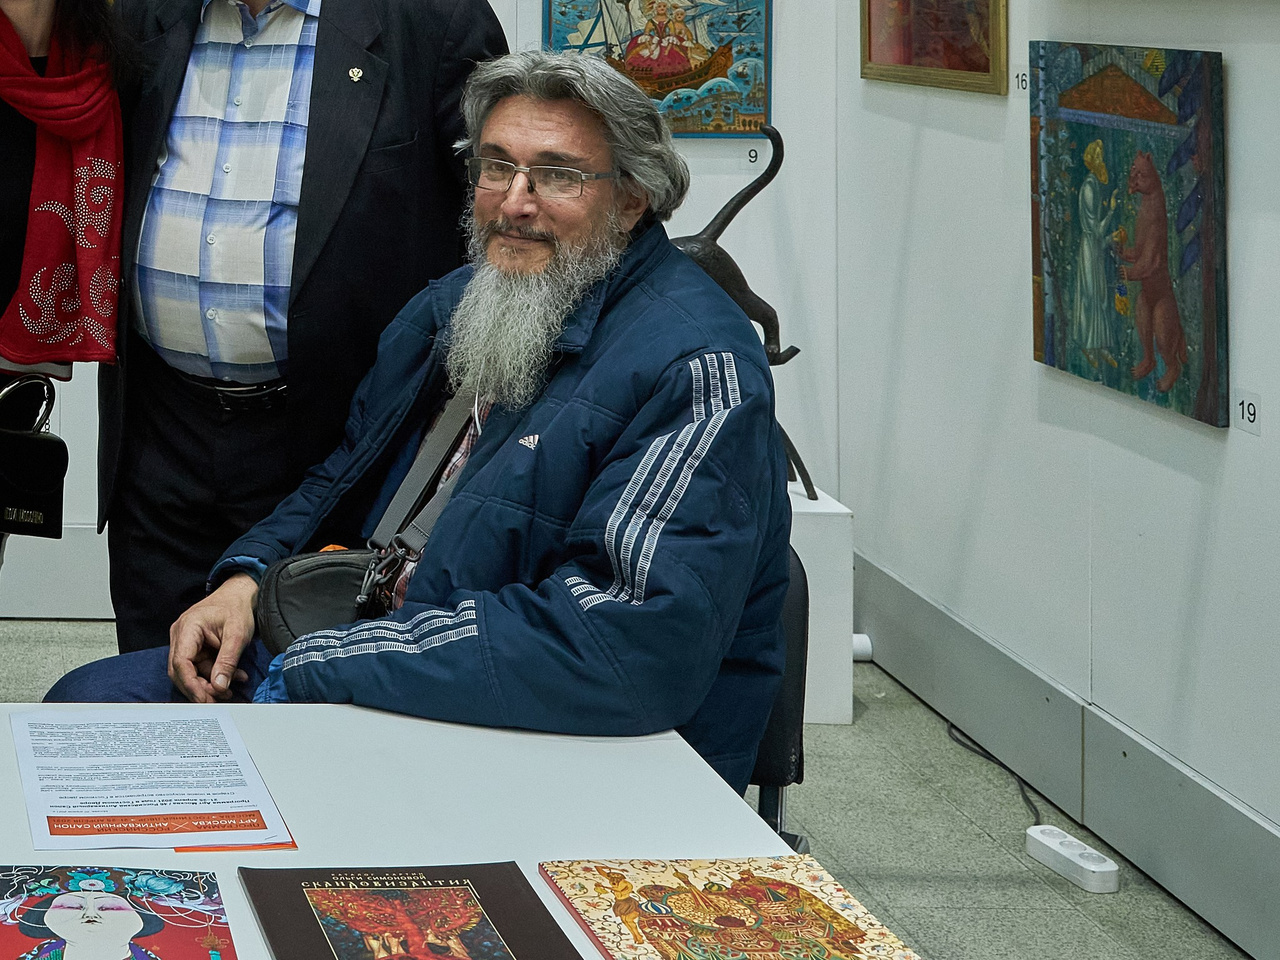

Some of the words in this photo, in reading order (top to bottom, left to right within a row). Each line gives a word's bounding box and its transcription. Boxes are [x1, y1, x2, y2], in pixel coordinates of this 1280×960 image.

[1015, 73, 1028, 90] 16
[748, 148, 758, 164] 9
[1238, 400, 1257, 424] 19
